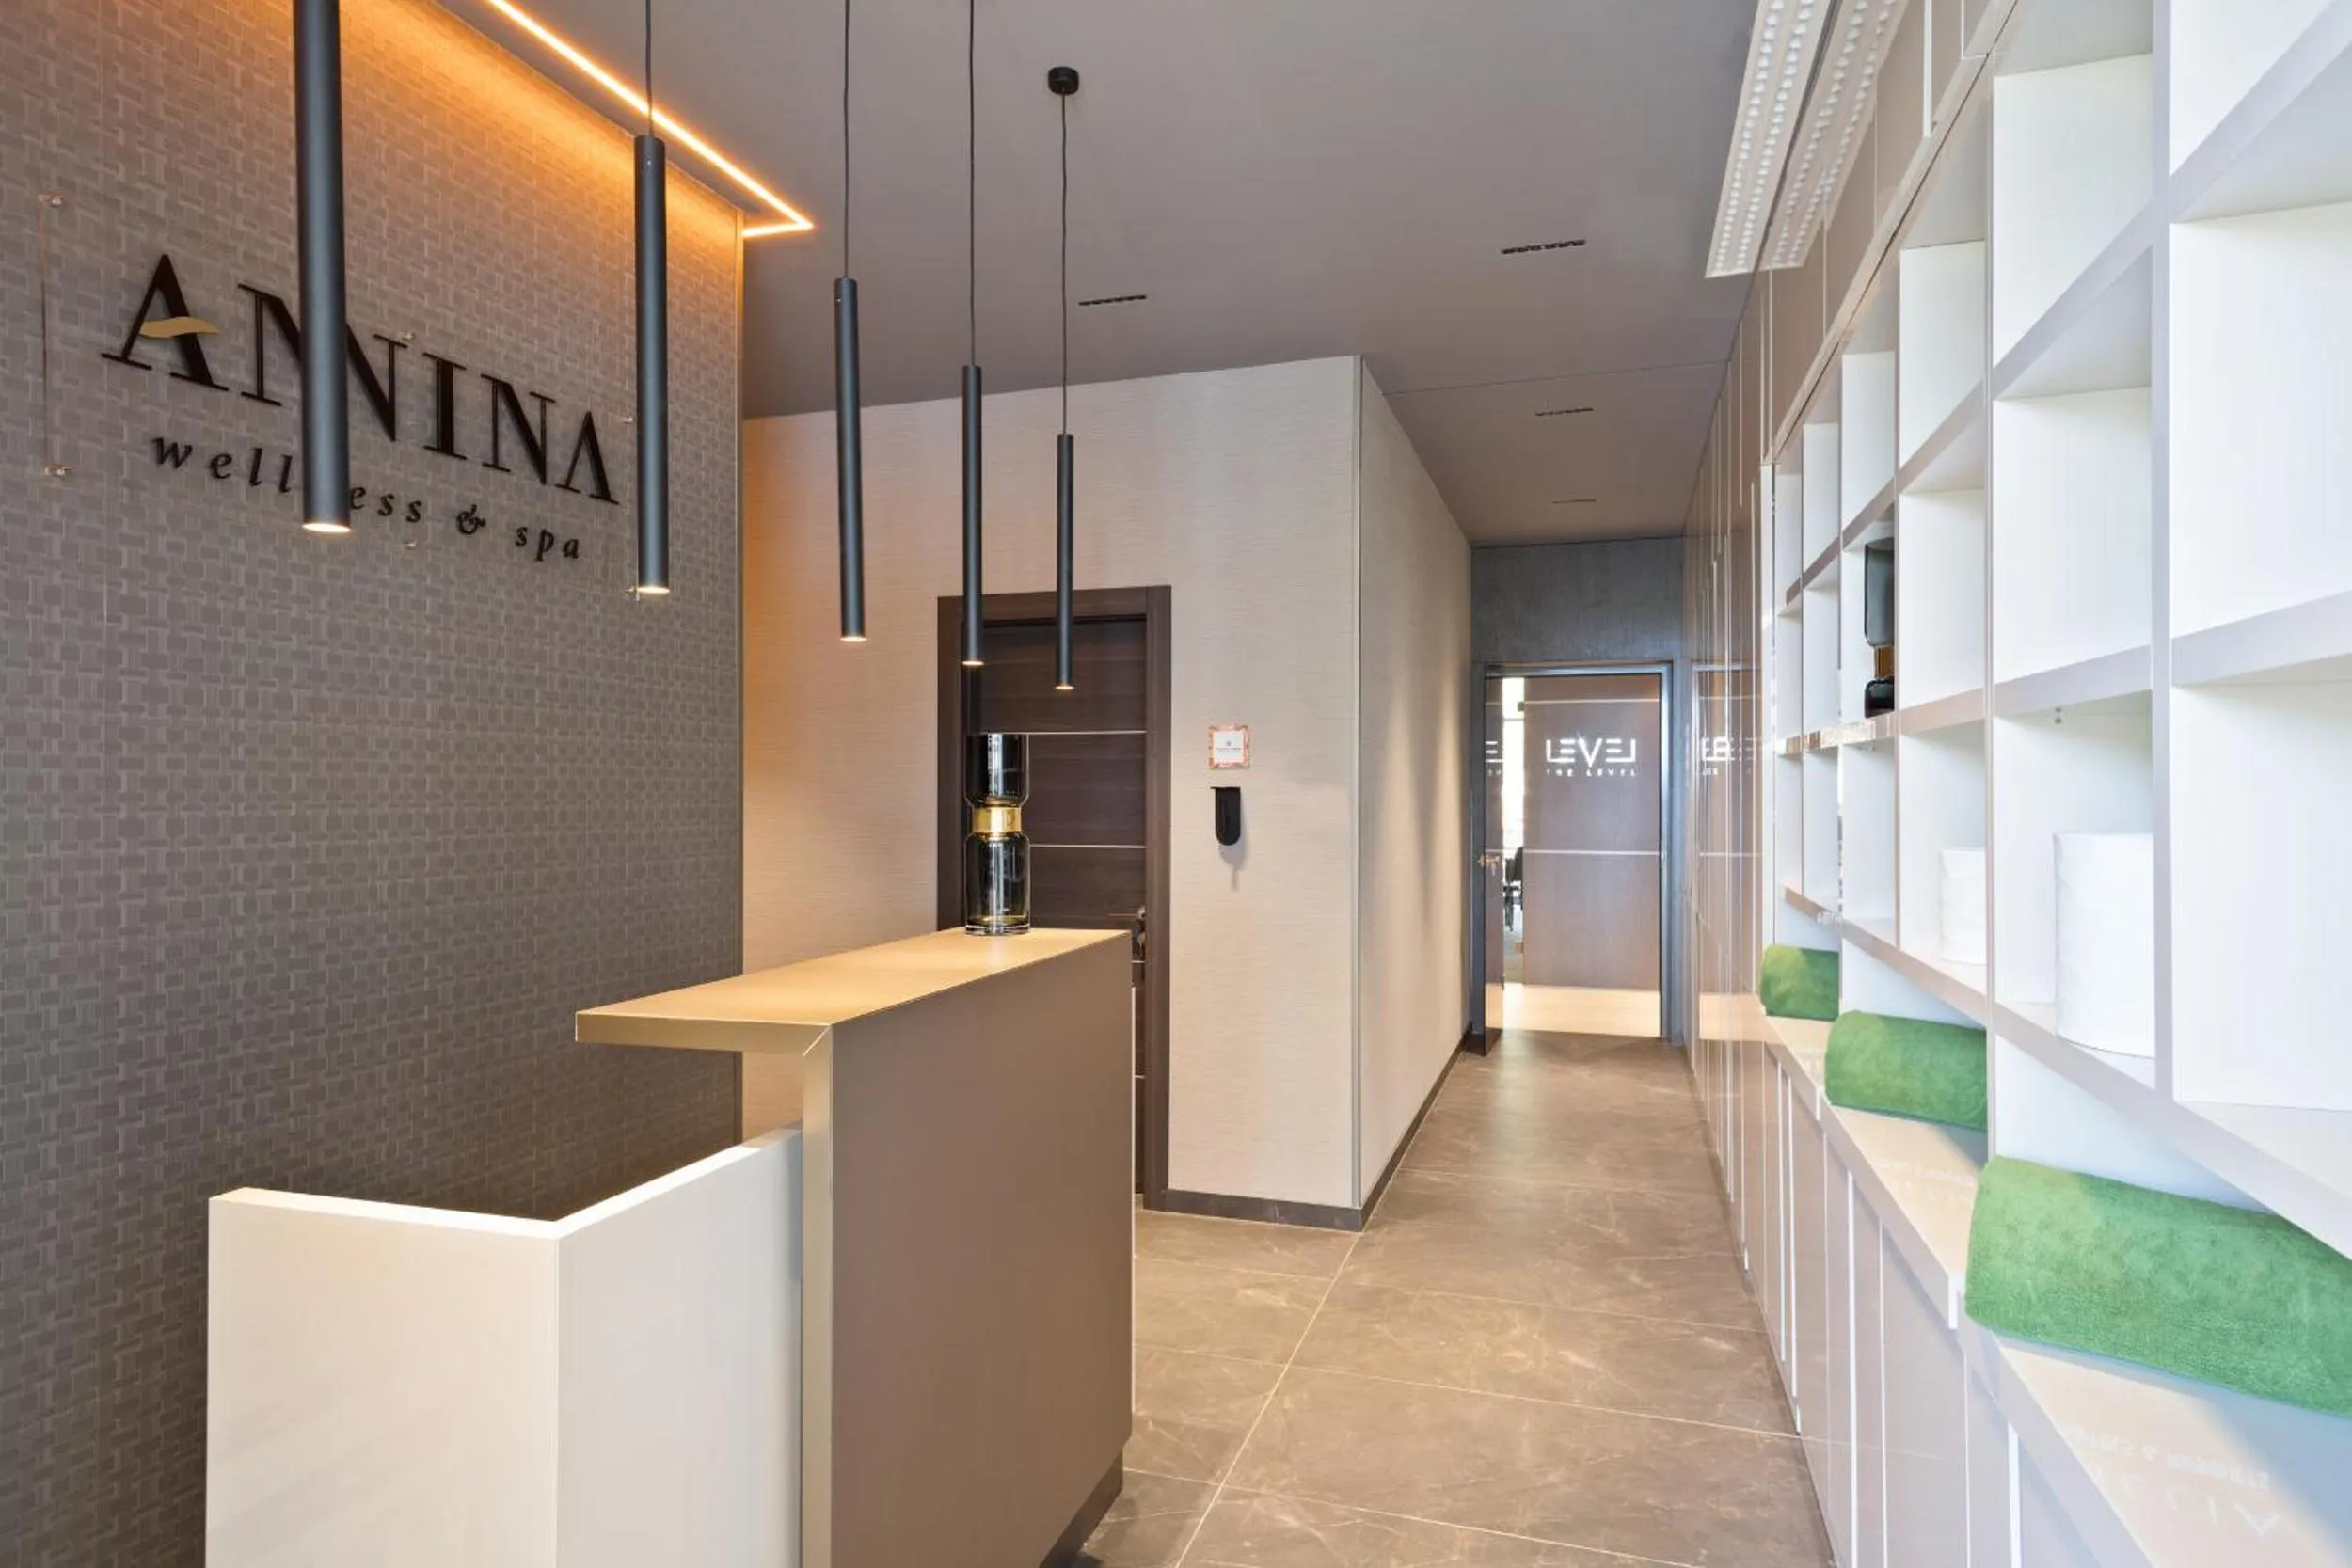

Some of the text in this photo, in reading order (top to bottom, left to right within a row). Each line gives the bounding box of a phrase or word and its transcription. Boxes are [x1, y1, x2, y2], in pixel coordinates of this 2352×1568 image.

[151, 436, 580, 561] welless & spa
[1545, 737, 1636, 767] LEVEL
